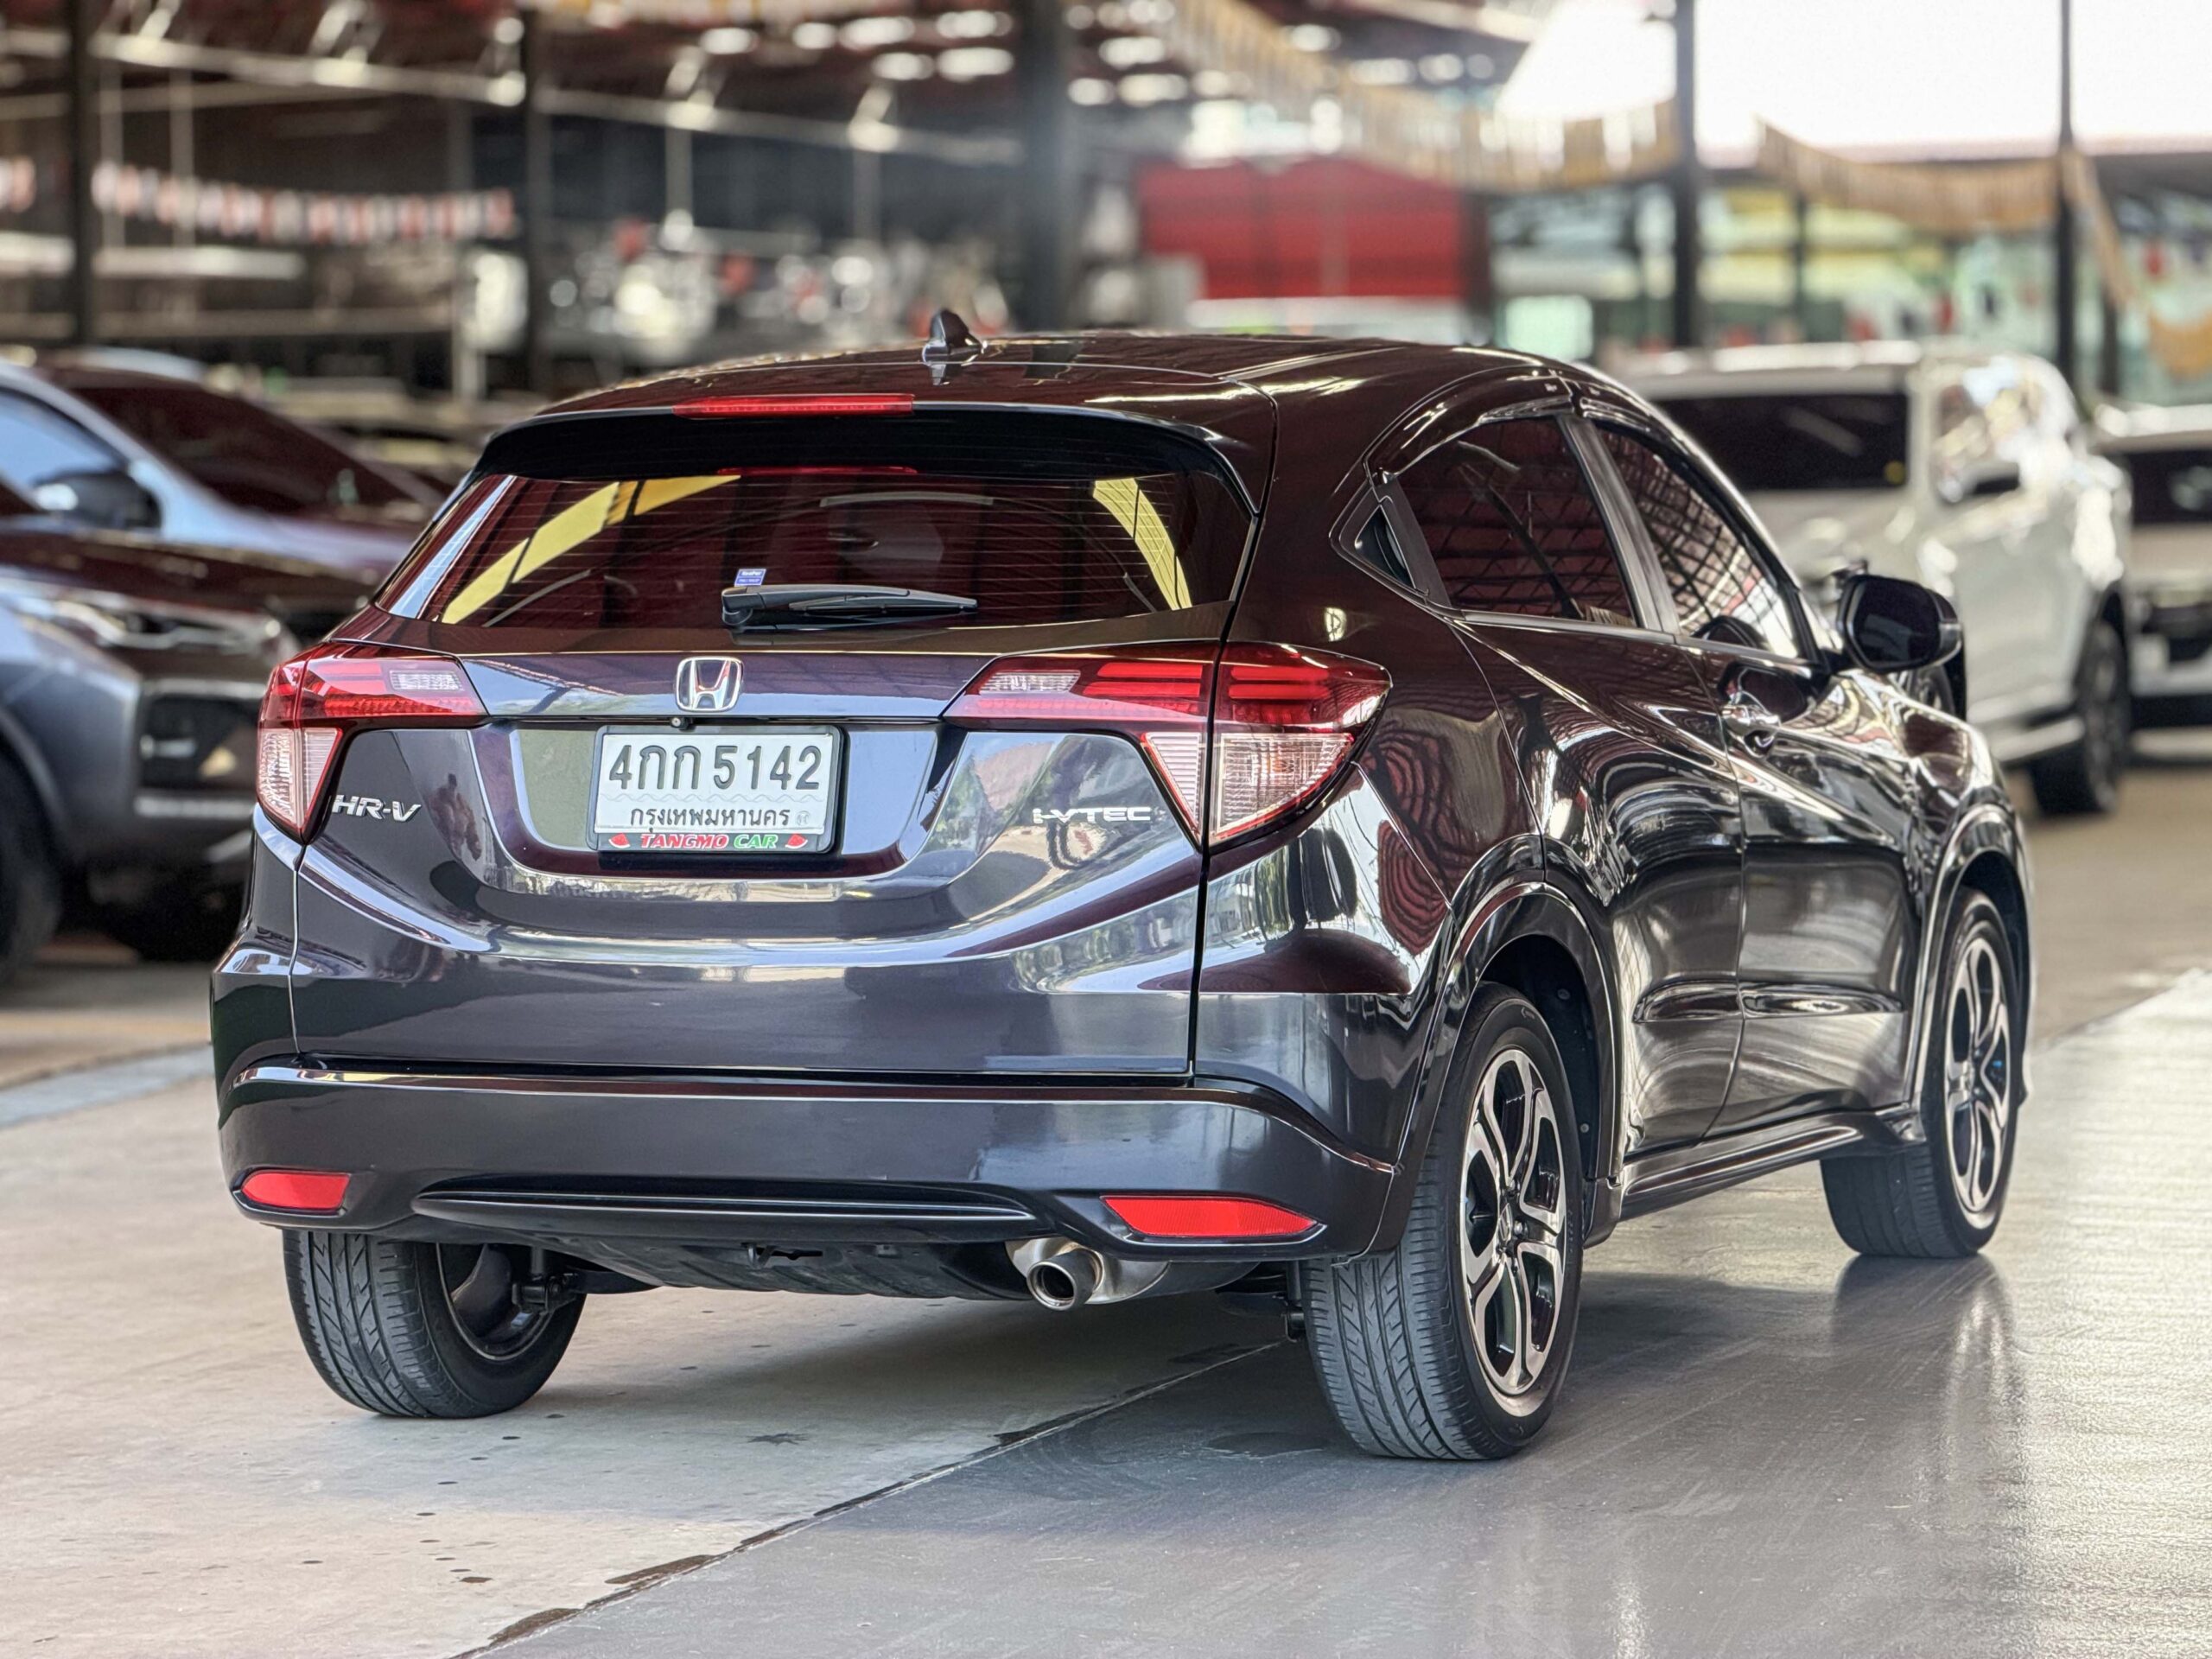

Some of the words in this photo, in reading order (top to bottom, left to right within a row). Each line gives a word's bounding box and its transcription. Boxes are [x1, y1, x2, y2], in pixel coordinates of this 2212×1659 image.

[608, 744, 702, 790] 4กก
[713, 745, 822, 790] 5142
[332, 794, 422, 822] HR-V
[630, 808, 791, 833] กรุงเทพมหานคร
[640, 833, 730, 849] TANGMO
[734, 833, 779, 849] CAR
